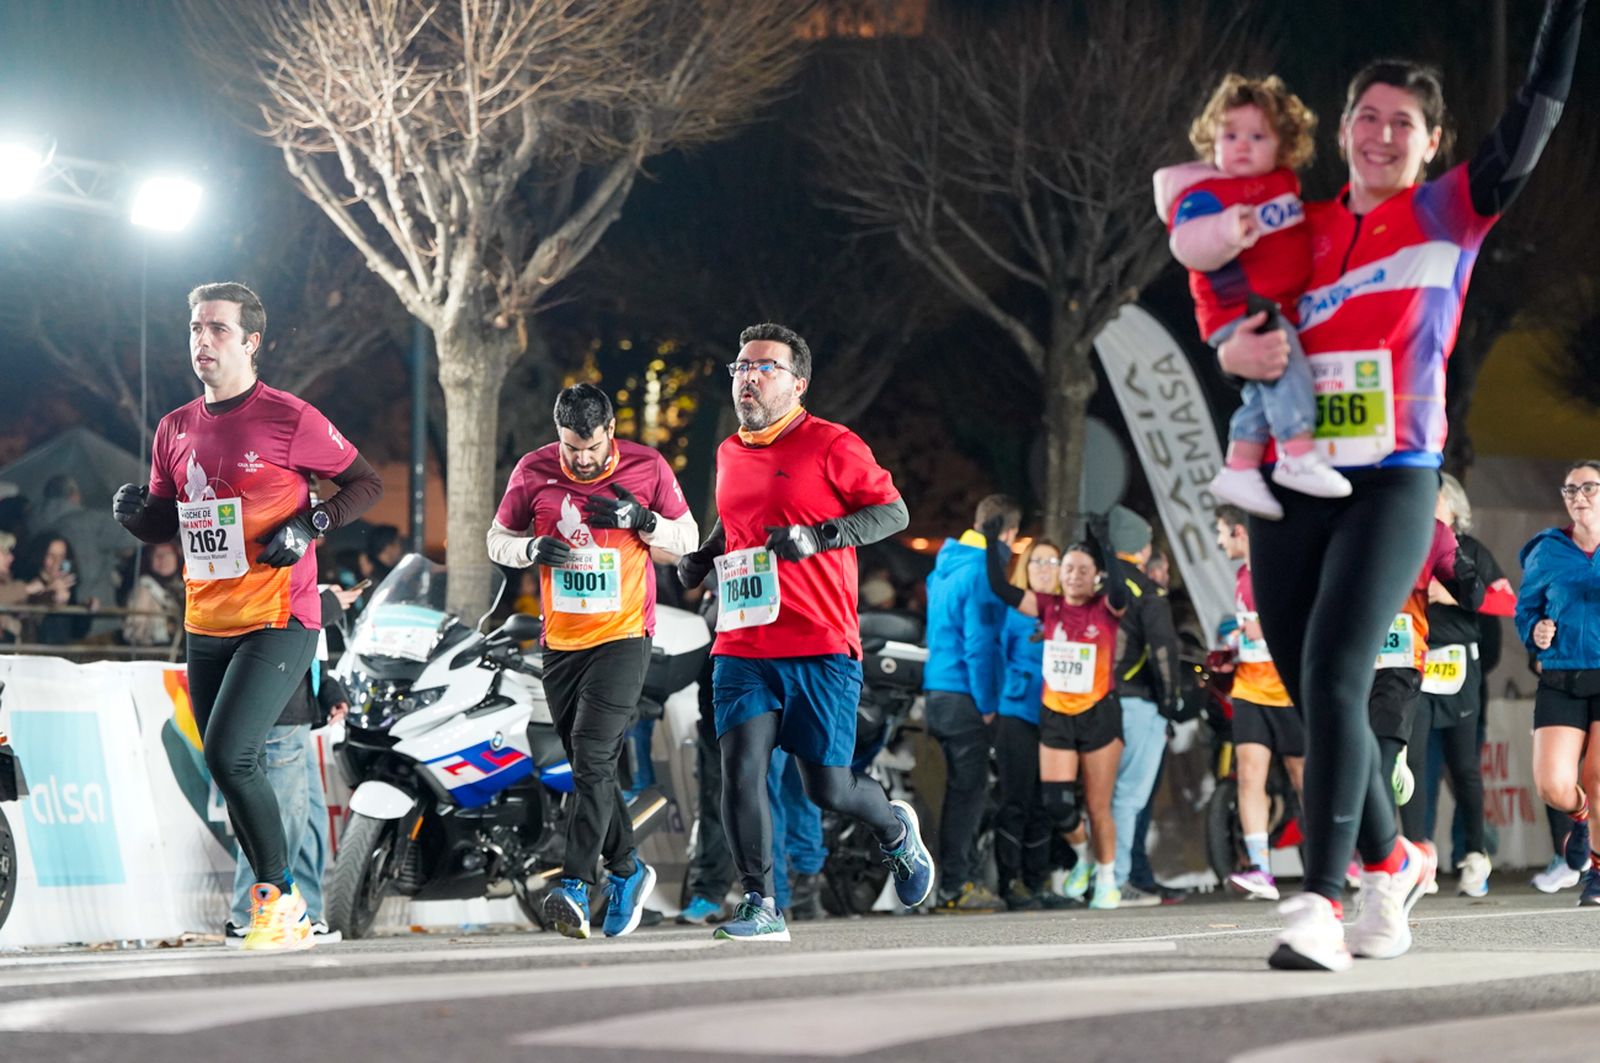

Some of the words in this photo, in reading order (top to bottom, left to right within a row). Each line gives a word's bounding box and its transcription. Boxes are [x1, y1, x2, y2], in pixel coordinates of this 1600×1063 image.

[187, 528, 229, 553] 2162
[571, 528, 590, 547] 43
[563, 571, 607, 592] 9001
[726, 575, 763, 603] 7840
[1053, 659, 1083, 675] 3379
[30, 774, 107, 825] alsa
